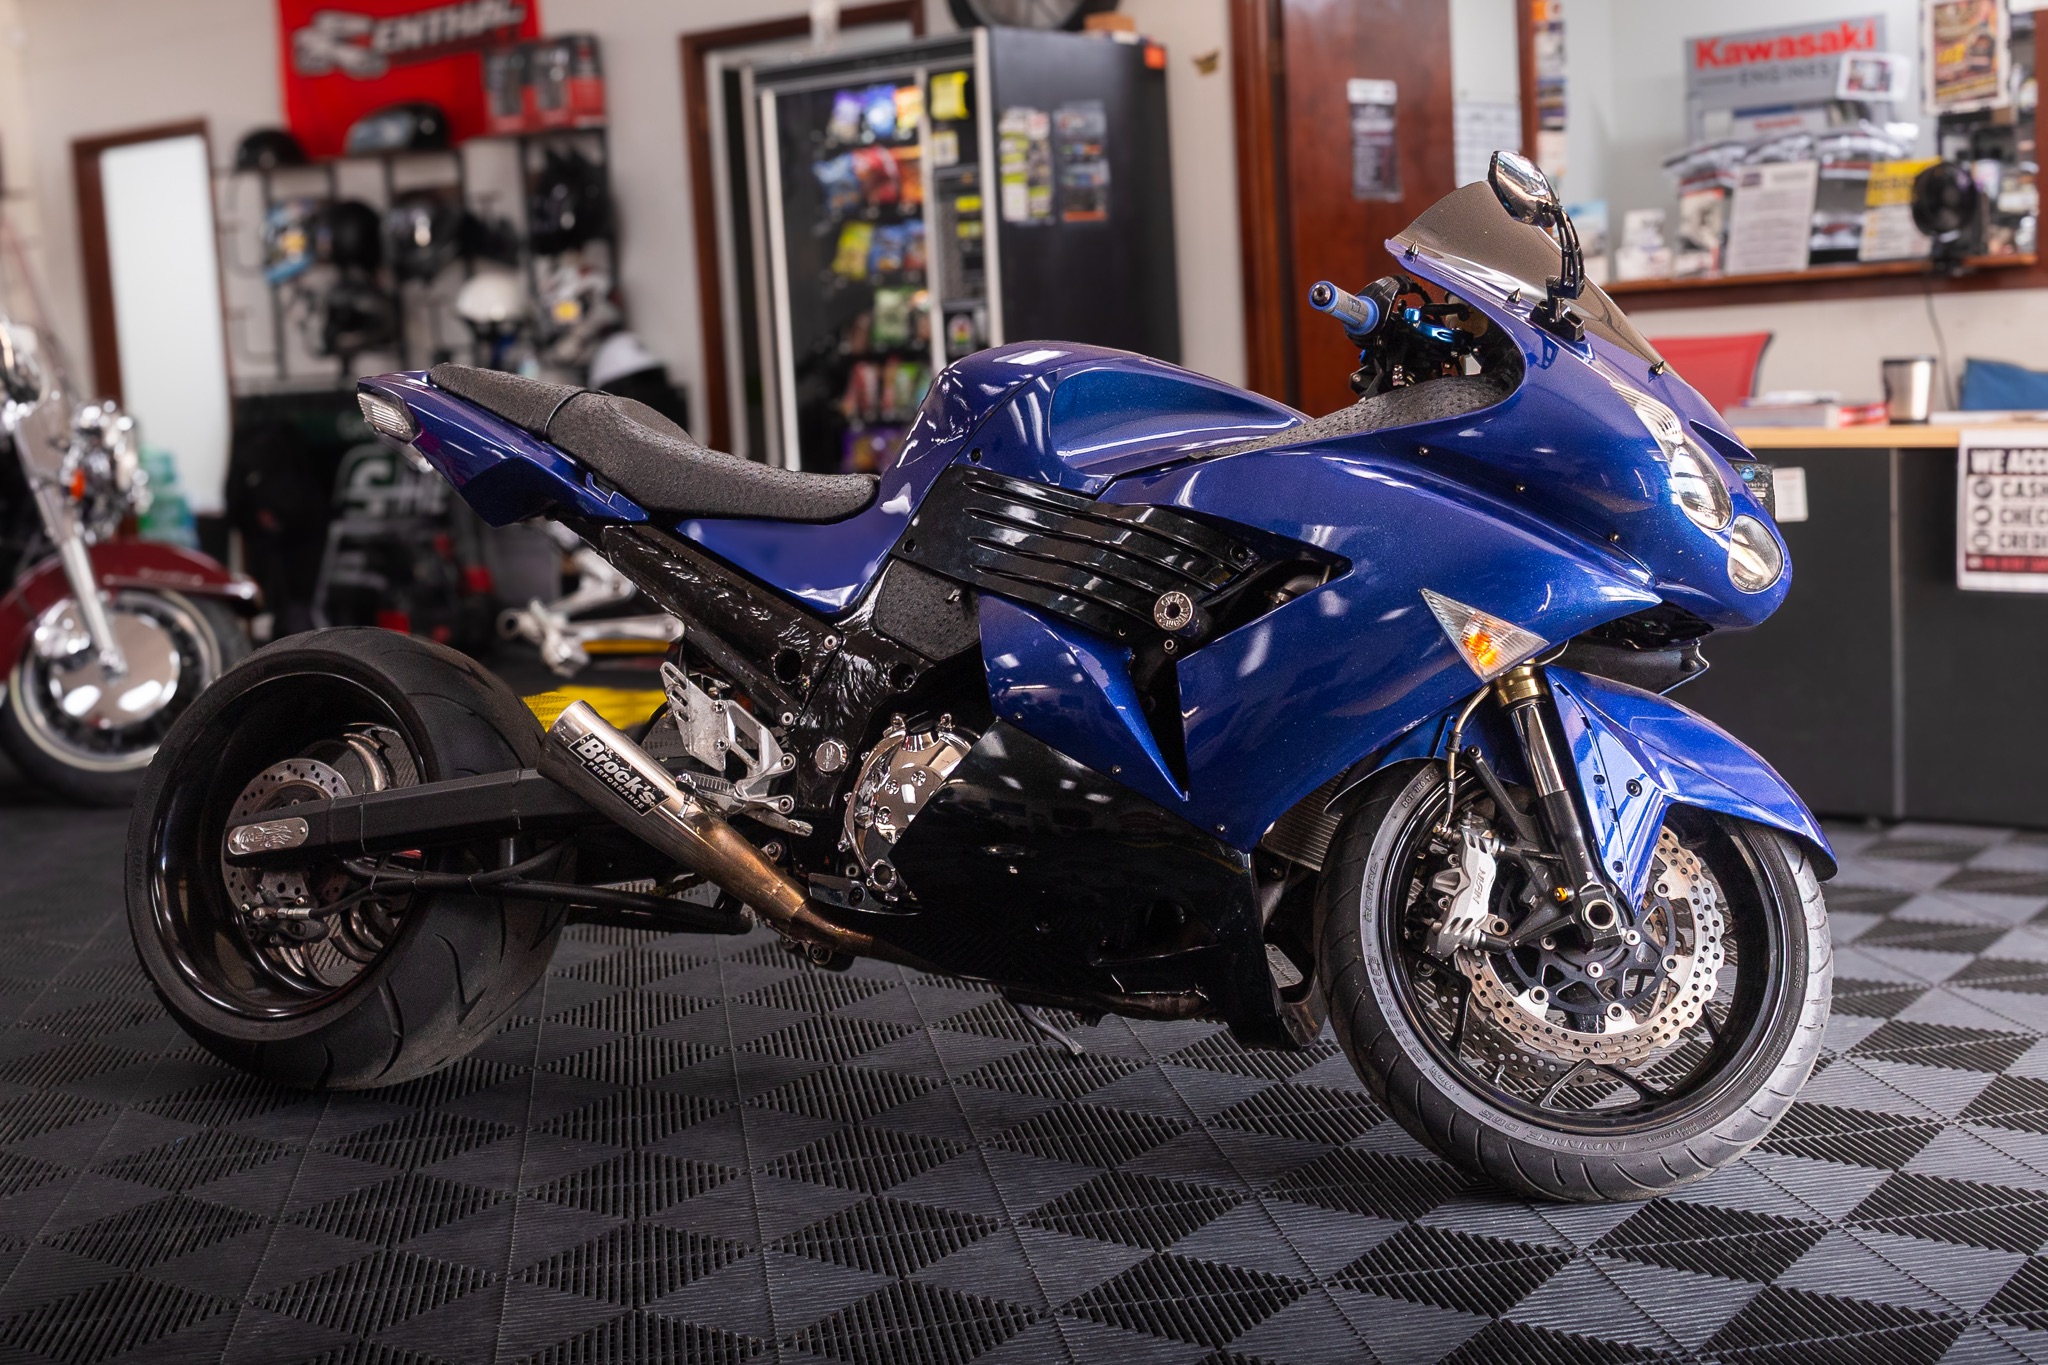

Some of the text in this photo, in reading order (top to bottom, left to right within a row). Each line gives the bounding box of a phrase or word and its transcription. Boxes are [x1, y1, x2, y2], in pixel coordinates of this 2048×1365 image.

[1694, 18, 1876, 70] Kawasaki
[576, 738, 656, 807] Brock's
[587, 761, 645, 809] PERFORMANCE
[1402, 793, 1414, 808] DOT
[1364, 862, 1379, 922] RADIAL
[1473, 866, 1486, 905] NISSIN
[1367, 955, 1428, 1064] SHINKO
